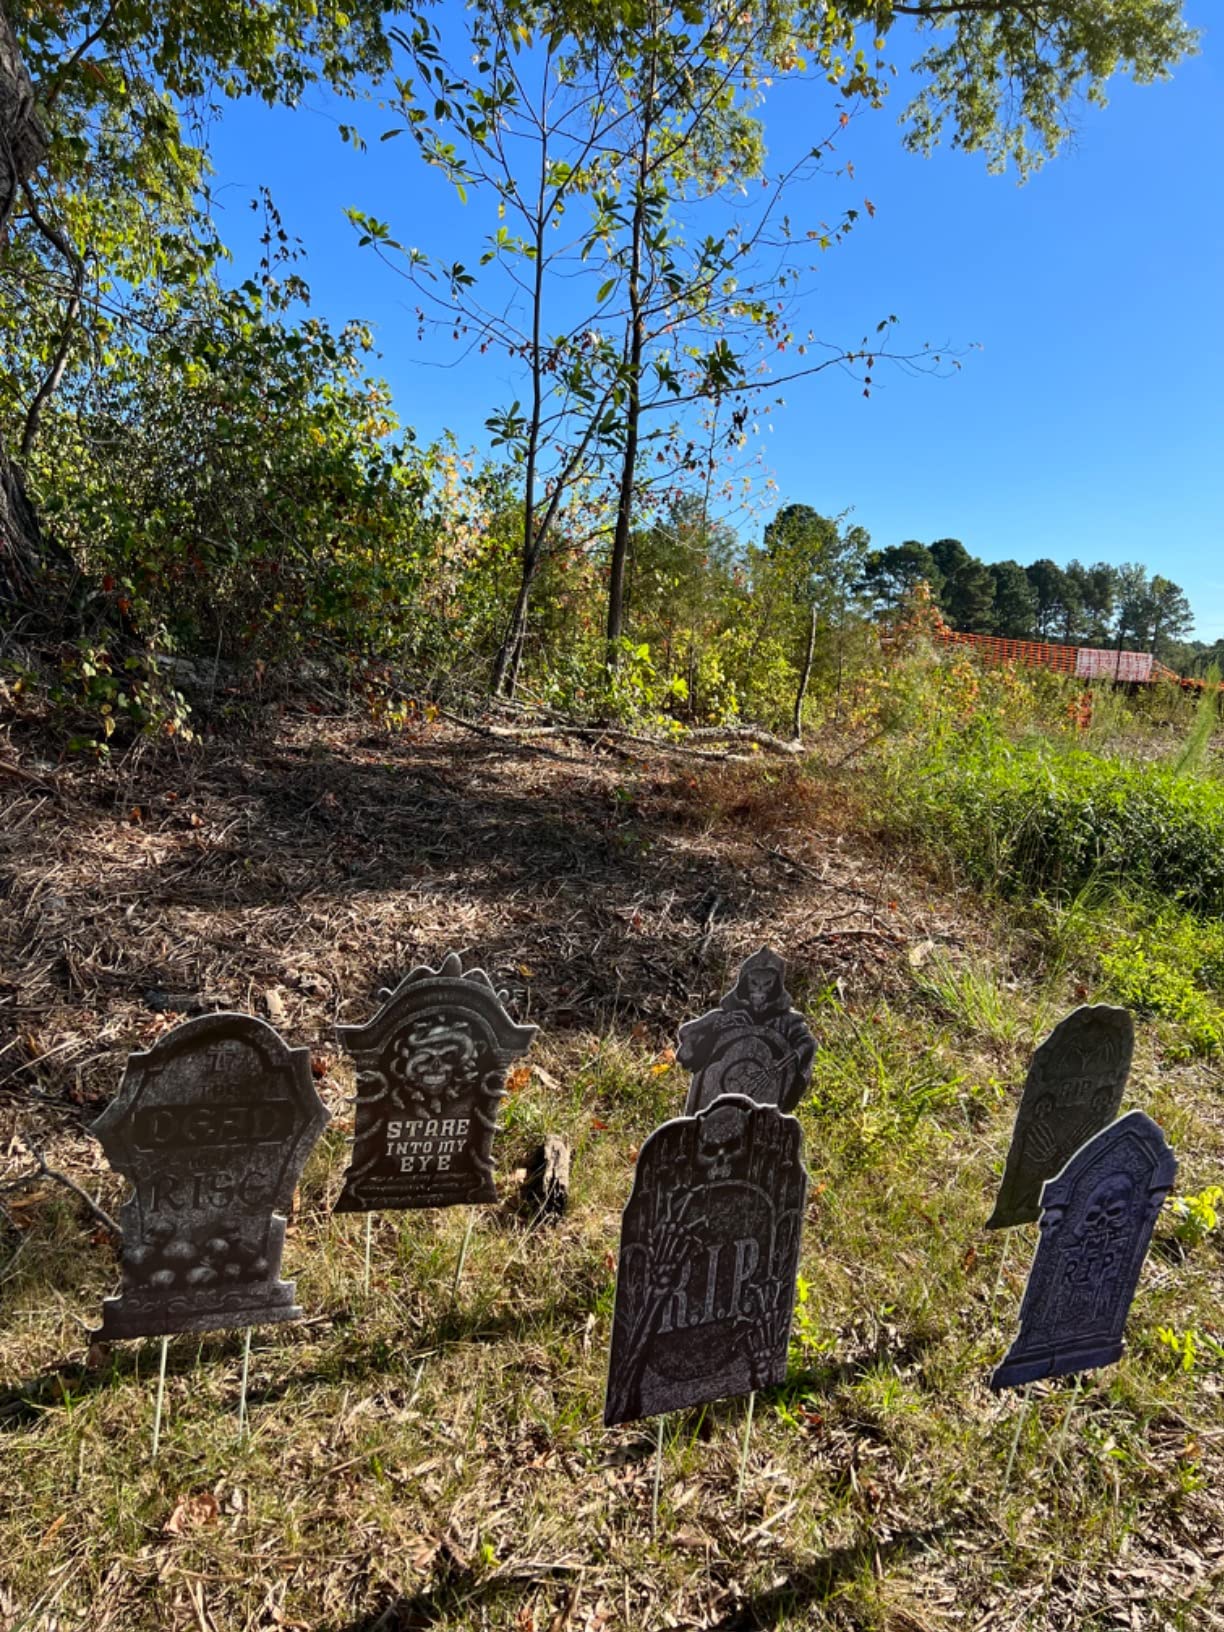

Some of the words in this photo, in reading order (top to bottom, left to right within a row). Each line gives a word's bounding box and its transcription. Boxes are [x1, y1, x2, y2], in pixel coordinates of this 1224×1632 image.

[385, 1118, 471, 1140] STARE
[385, 1140, 433, 1157] INTO
[437, 1138, 468, 1155] MY
[399, 1154, 453, 1173] EYE
[1061, 1251, 1115, 1285] RIP
